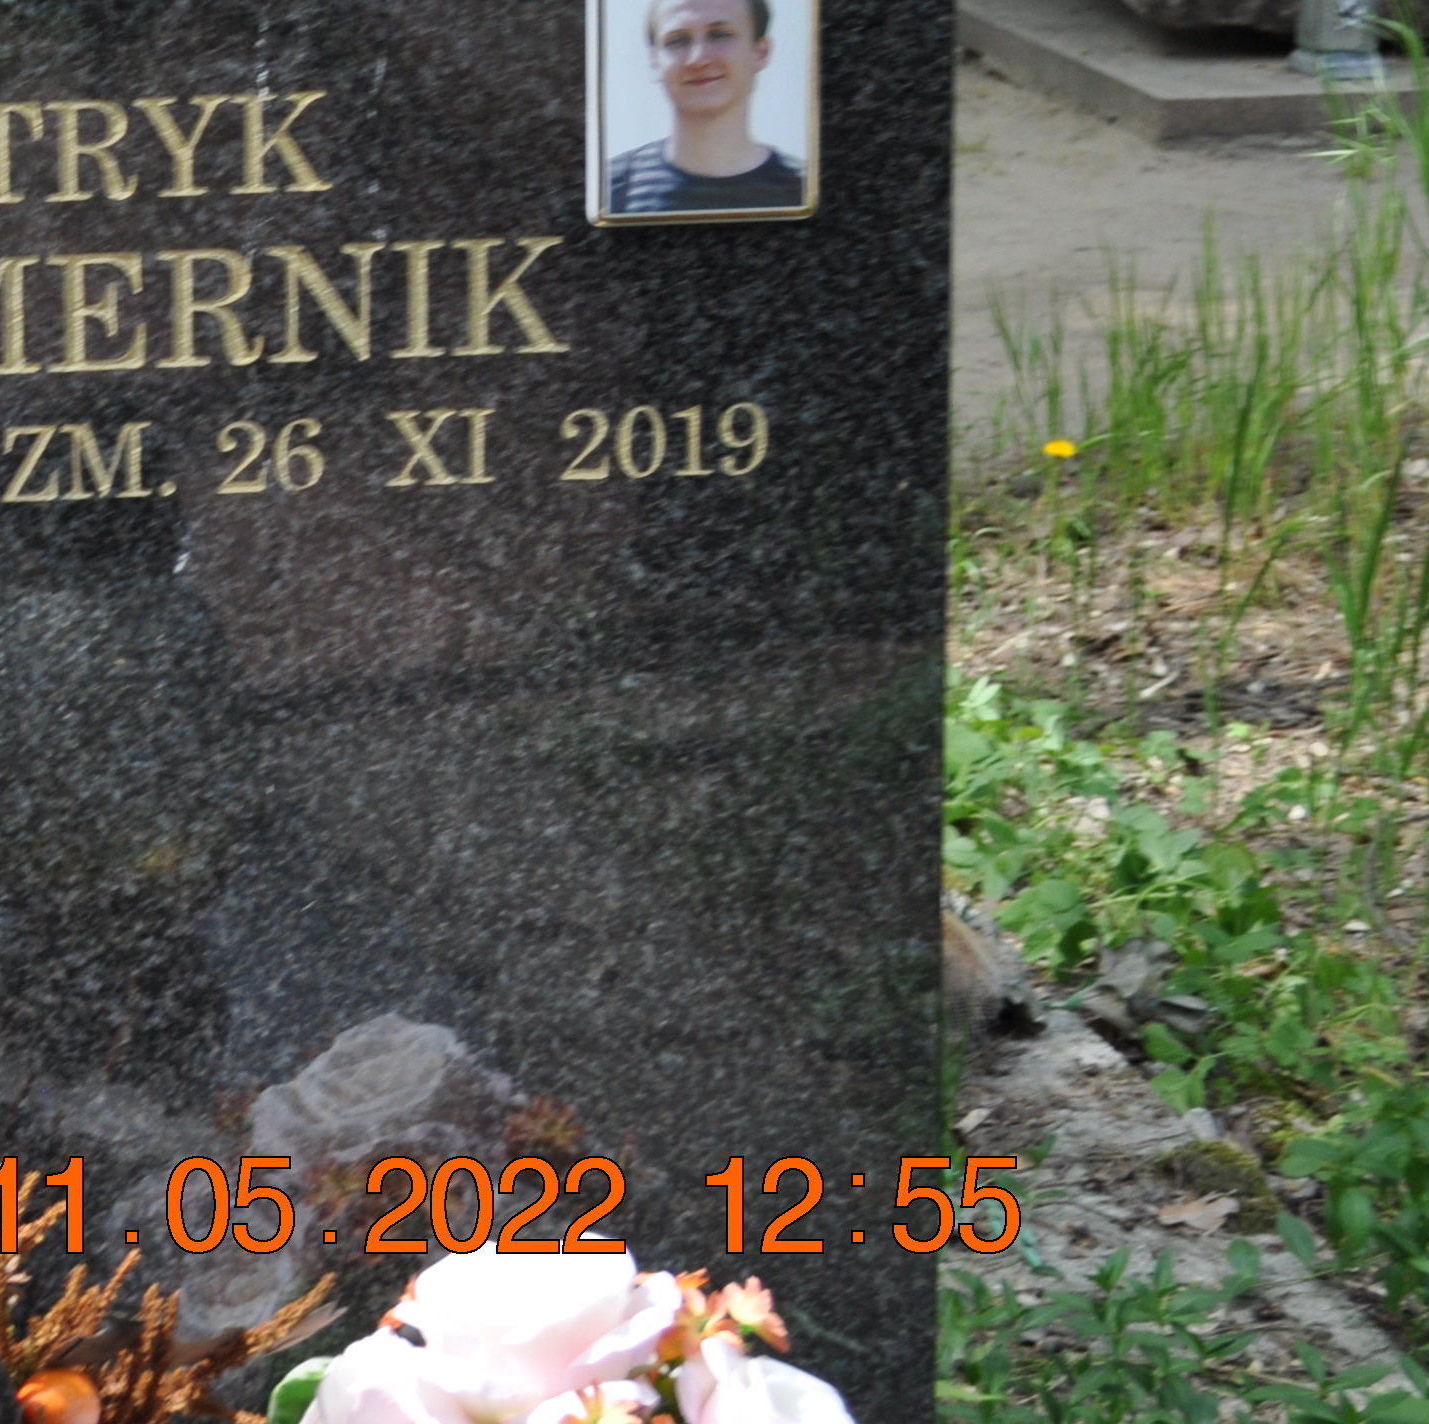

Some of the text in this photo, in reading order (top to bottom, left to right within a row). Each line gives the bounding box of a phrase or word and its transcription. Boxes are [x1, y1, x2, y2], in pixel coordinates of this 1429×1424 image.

[1, 421, 177, 505] ZM.
[216, 418, 327, 497] 26
[387, 407, 497, 488] XI
[560, 401, 770, 484] 2019
